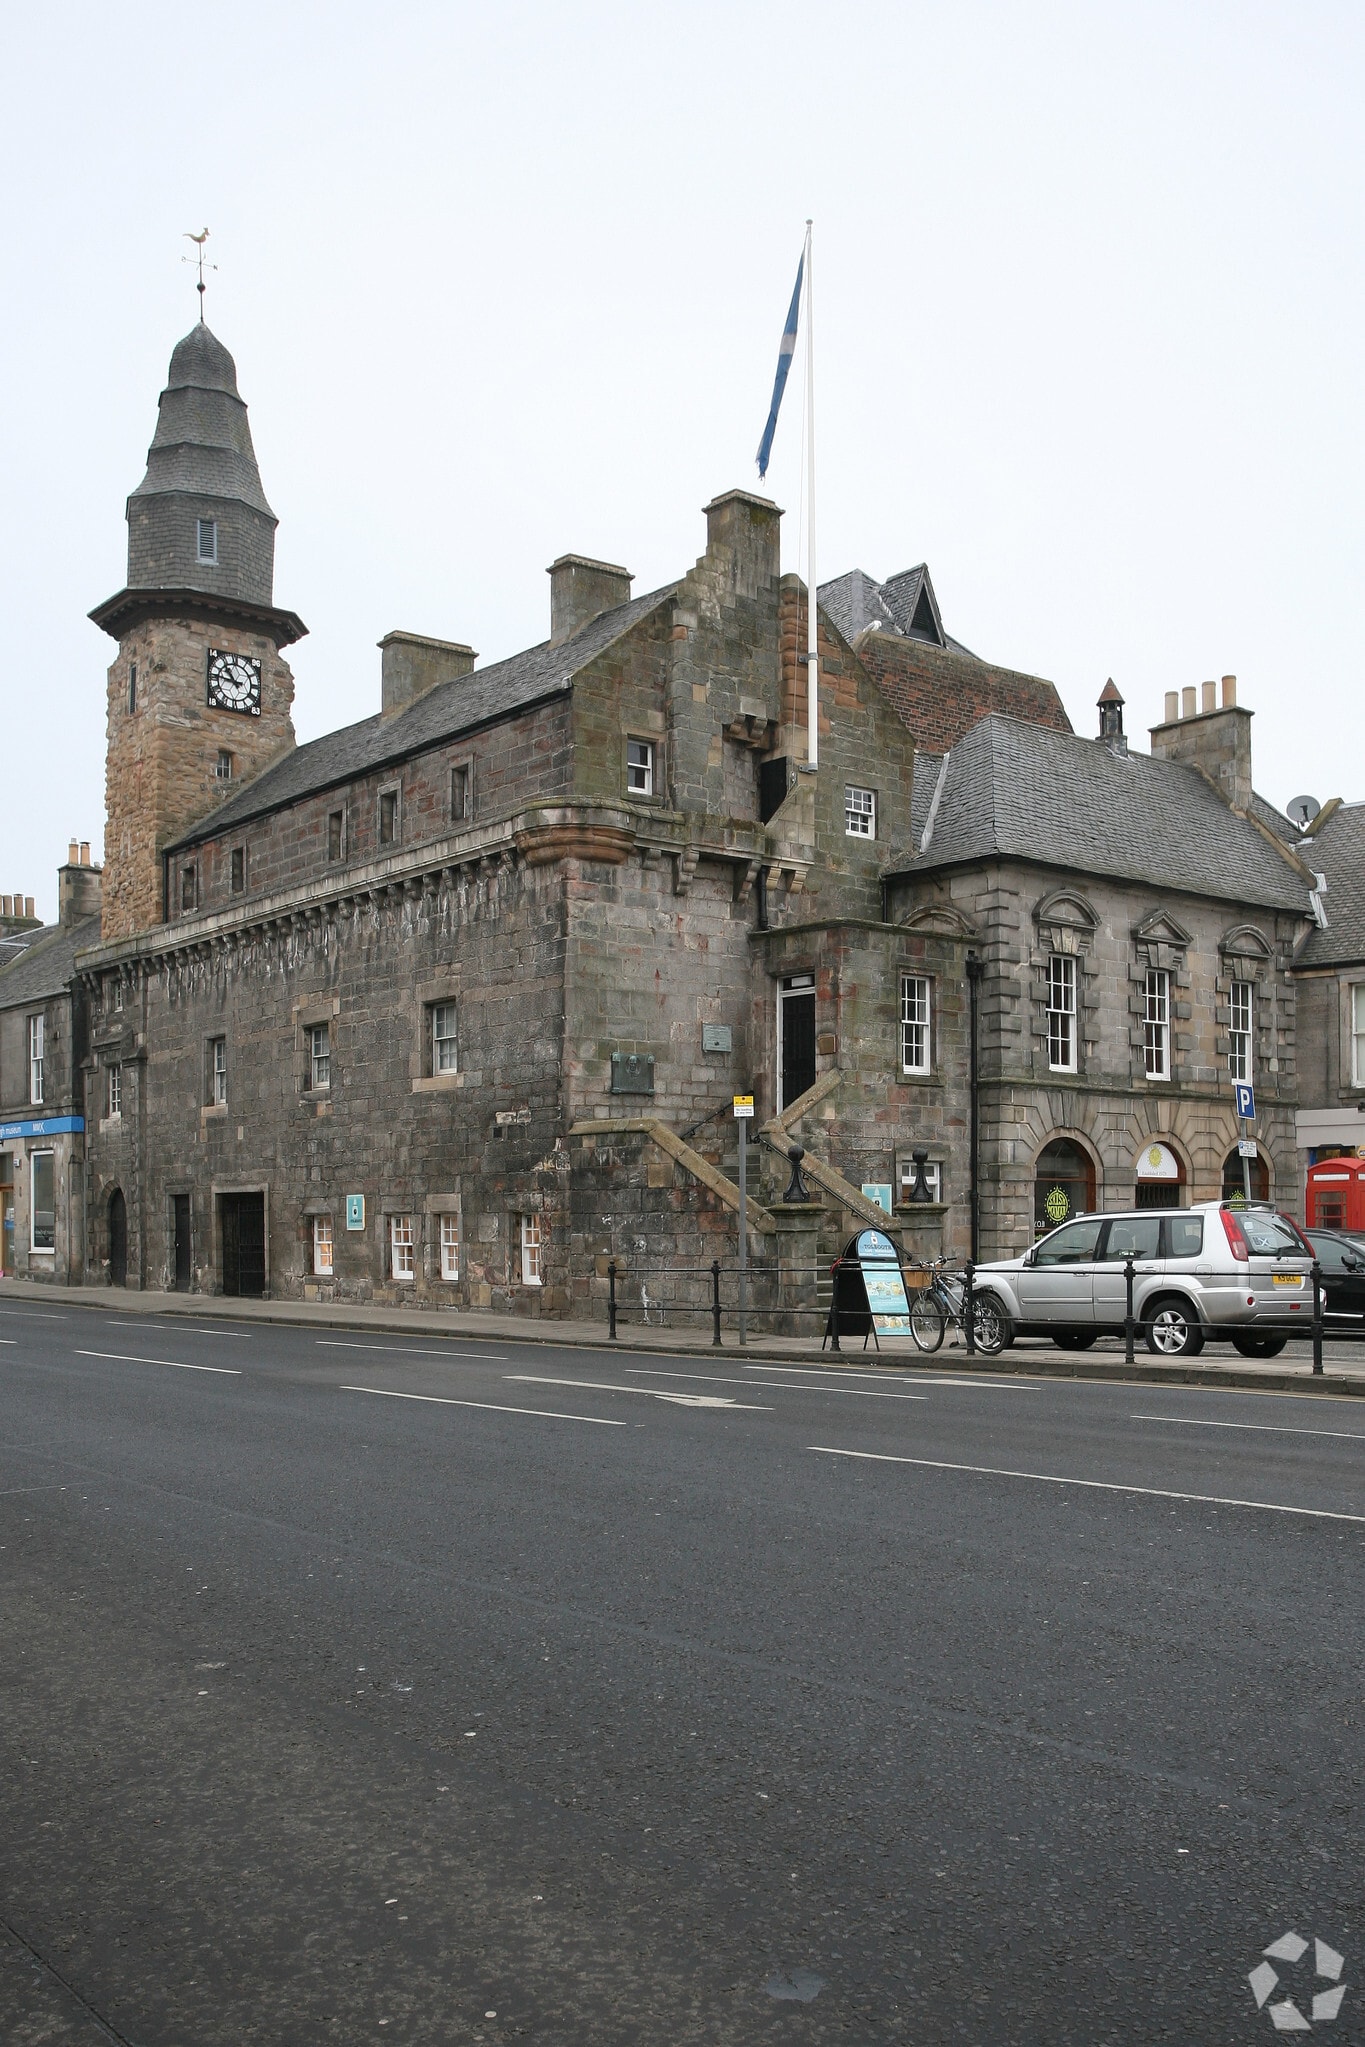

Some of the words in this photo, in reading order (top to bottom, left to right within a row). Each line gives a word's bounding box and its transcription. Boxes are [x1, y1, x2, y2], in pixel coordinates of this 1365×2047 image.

[209, 649, 218, 658] 14
[208, 697, 217, 706] 18
[1240, 1088, 1250, 1113] P
